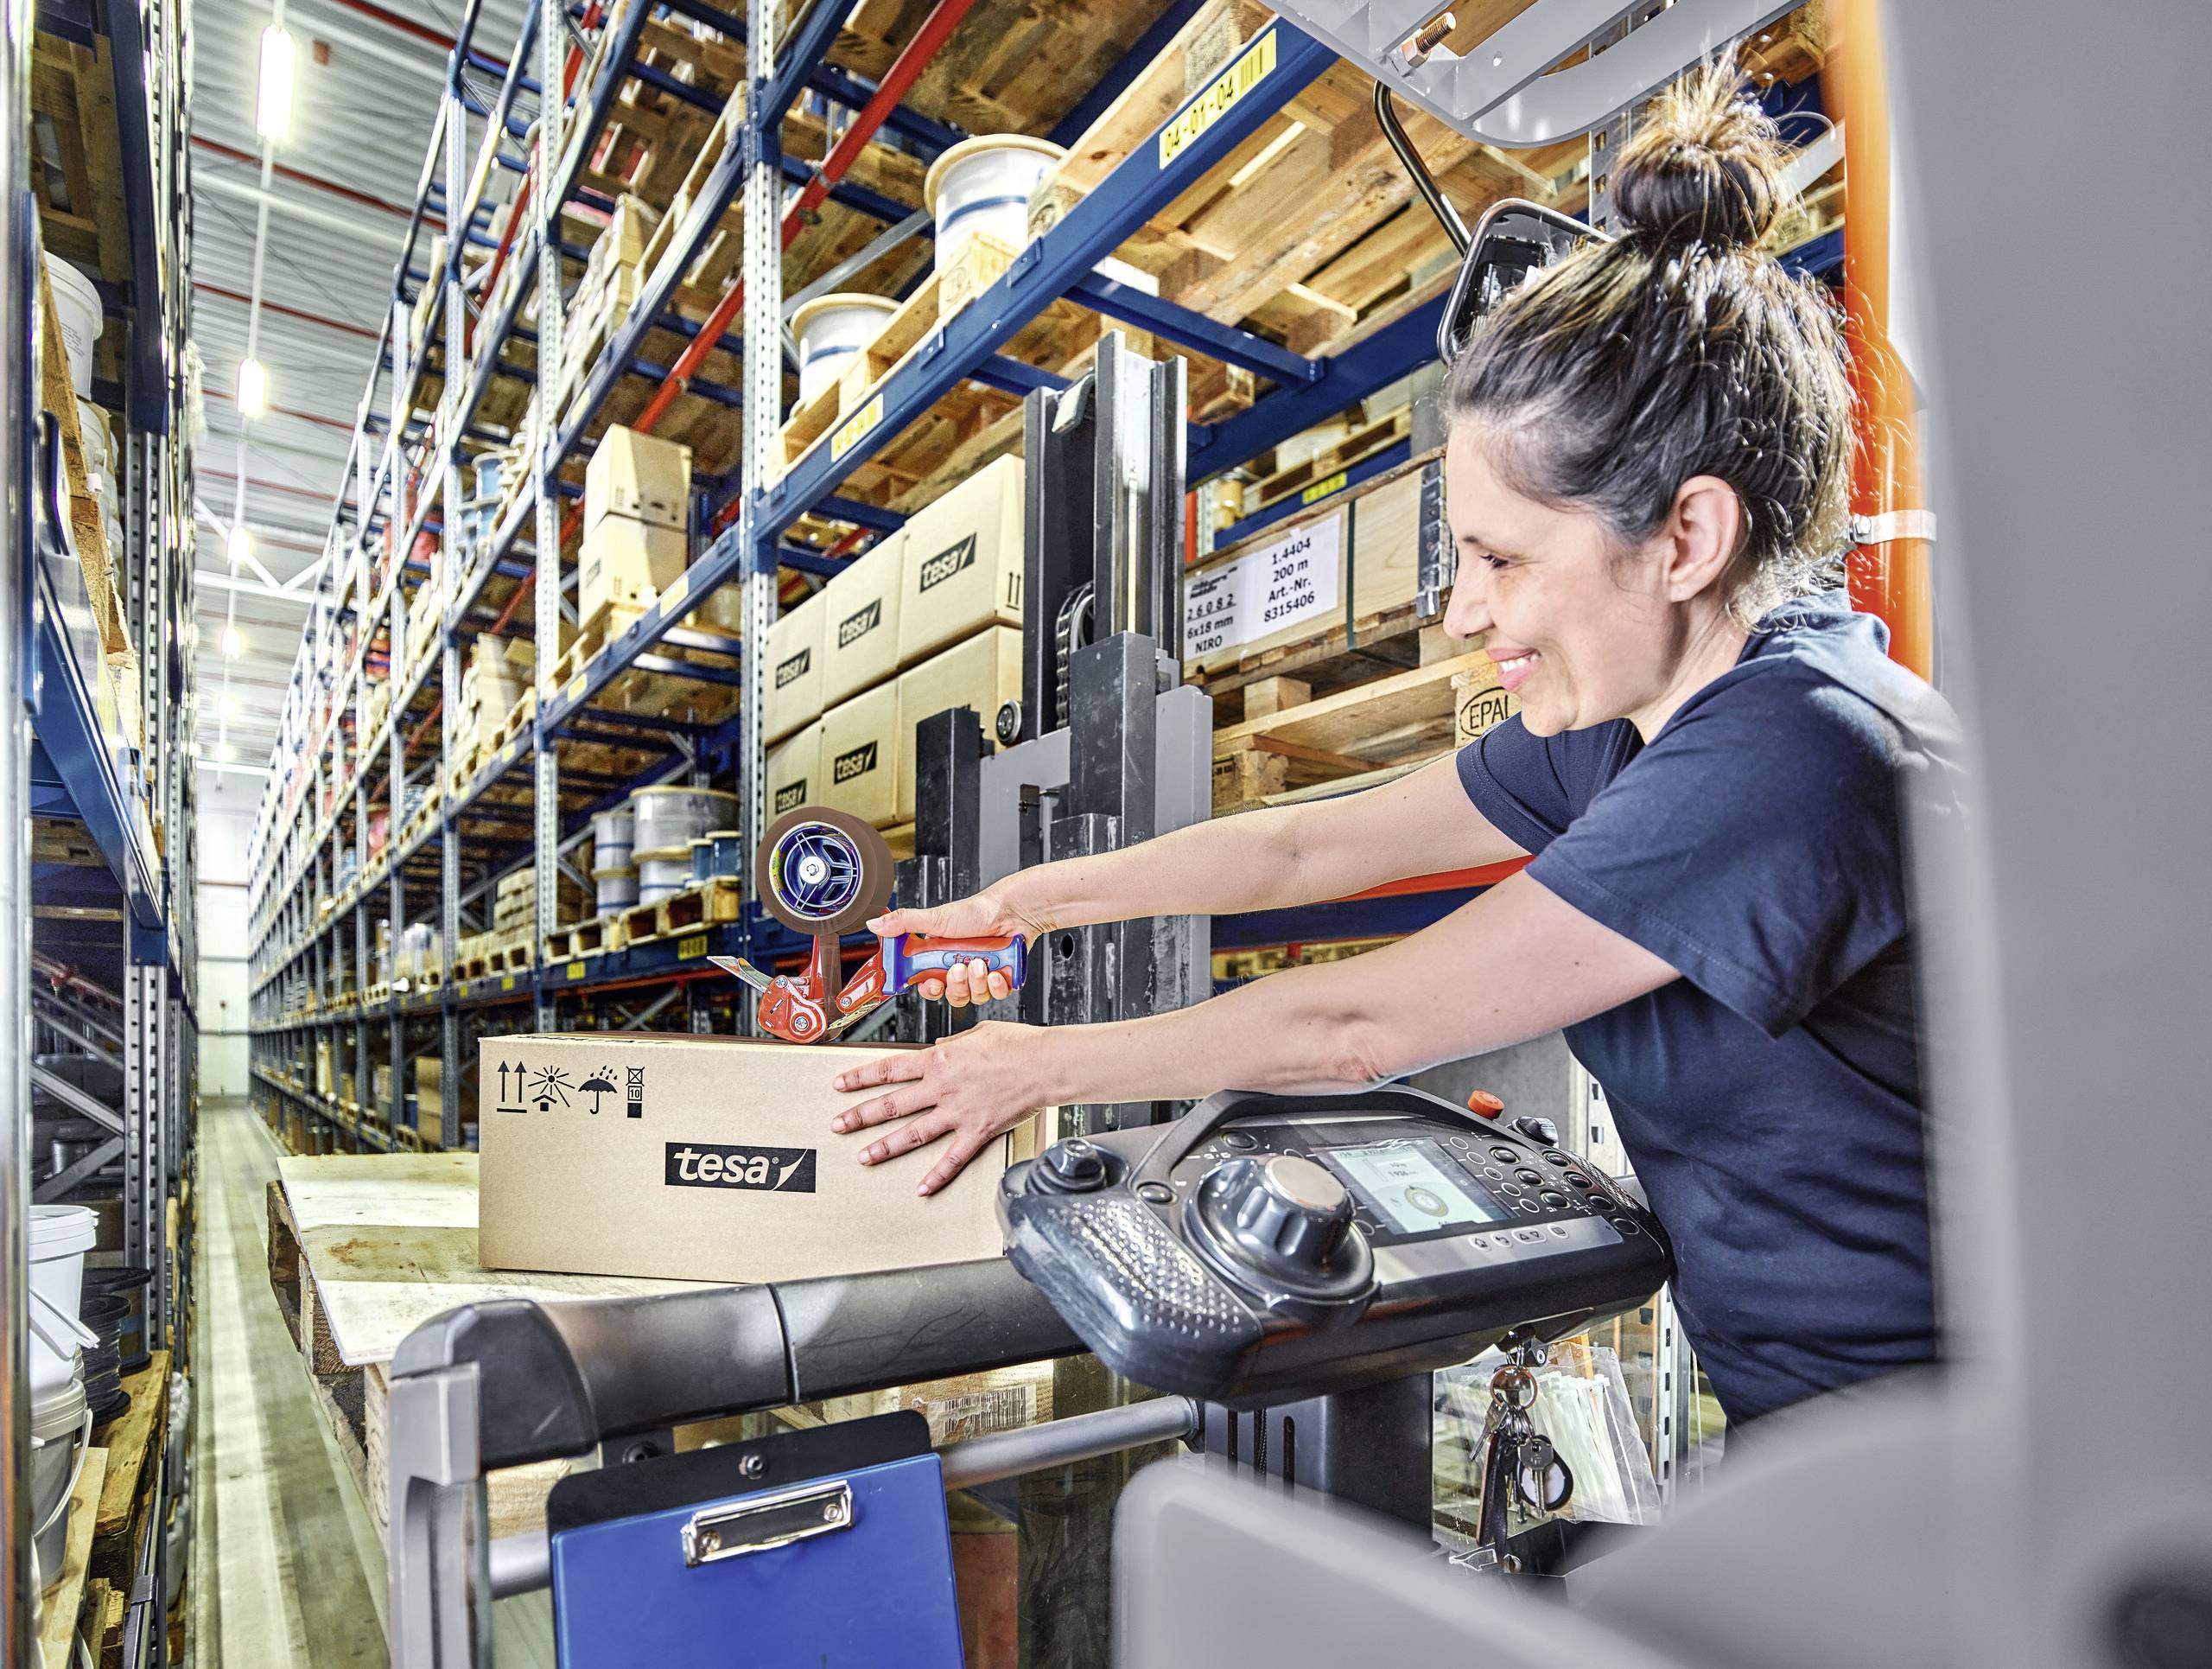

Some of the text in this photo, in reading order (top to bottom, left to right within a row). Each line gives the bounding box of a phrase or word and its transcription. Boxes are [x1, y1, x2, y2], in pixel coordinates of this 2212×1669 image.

[1272, 537, 1311, 565] 1.4404
[922, 551, 959, 588] tesa
[1273, 559, 1308, 583] 200 m
[1268, 577, 1312, 603] Art.-Nr.
[1264, 590, 1315, 622] 8315406
[1187, 615, 1234, 640] 6x18 mm
[1195, 634, 1223, 653] NIRO
[630, 1089, 640, 1099] 10
